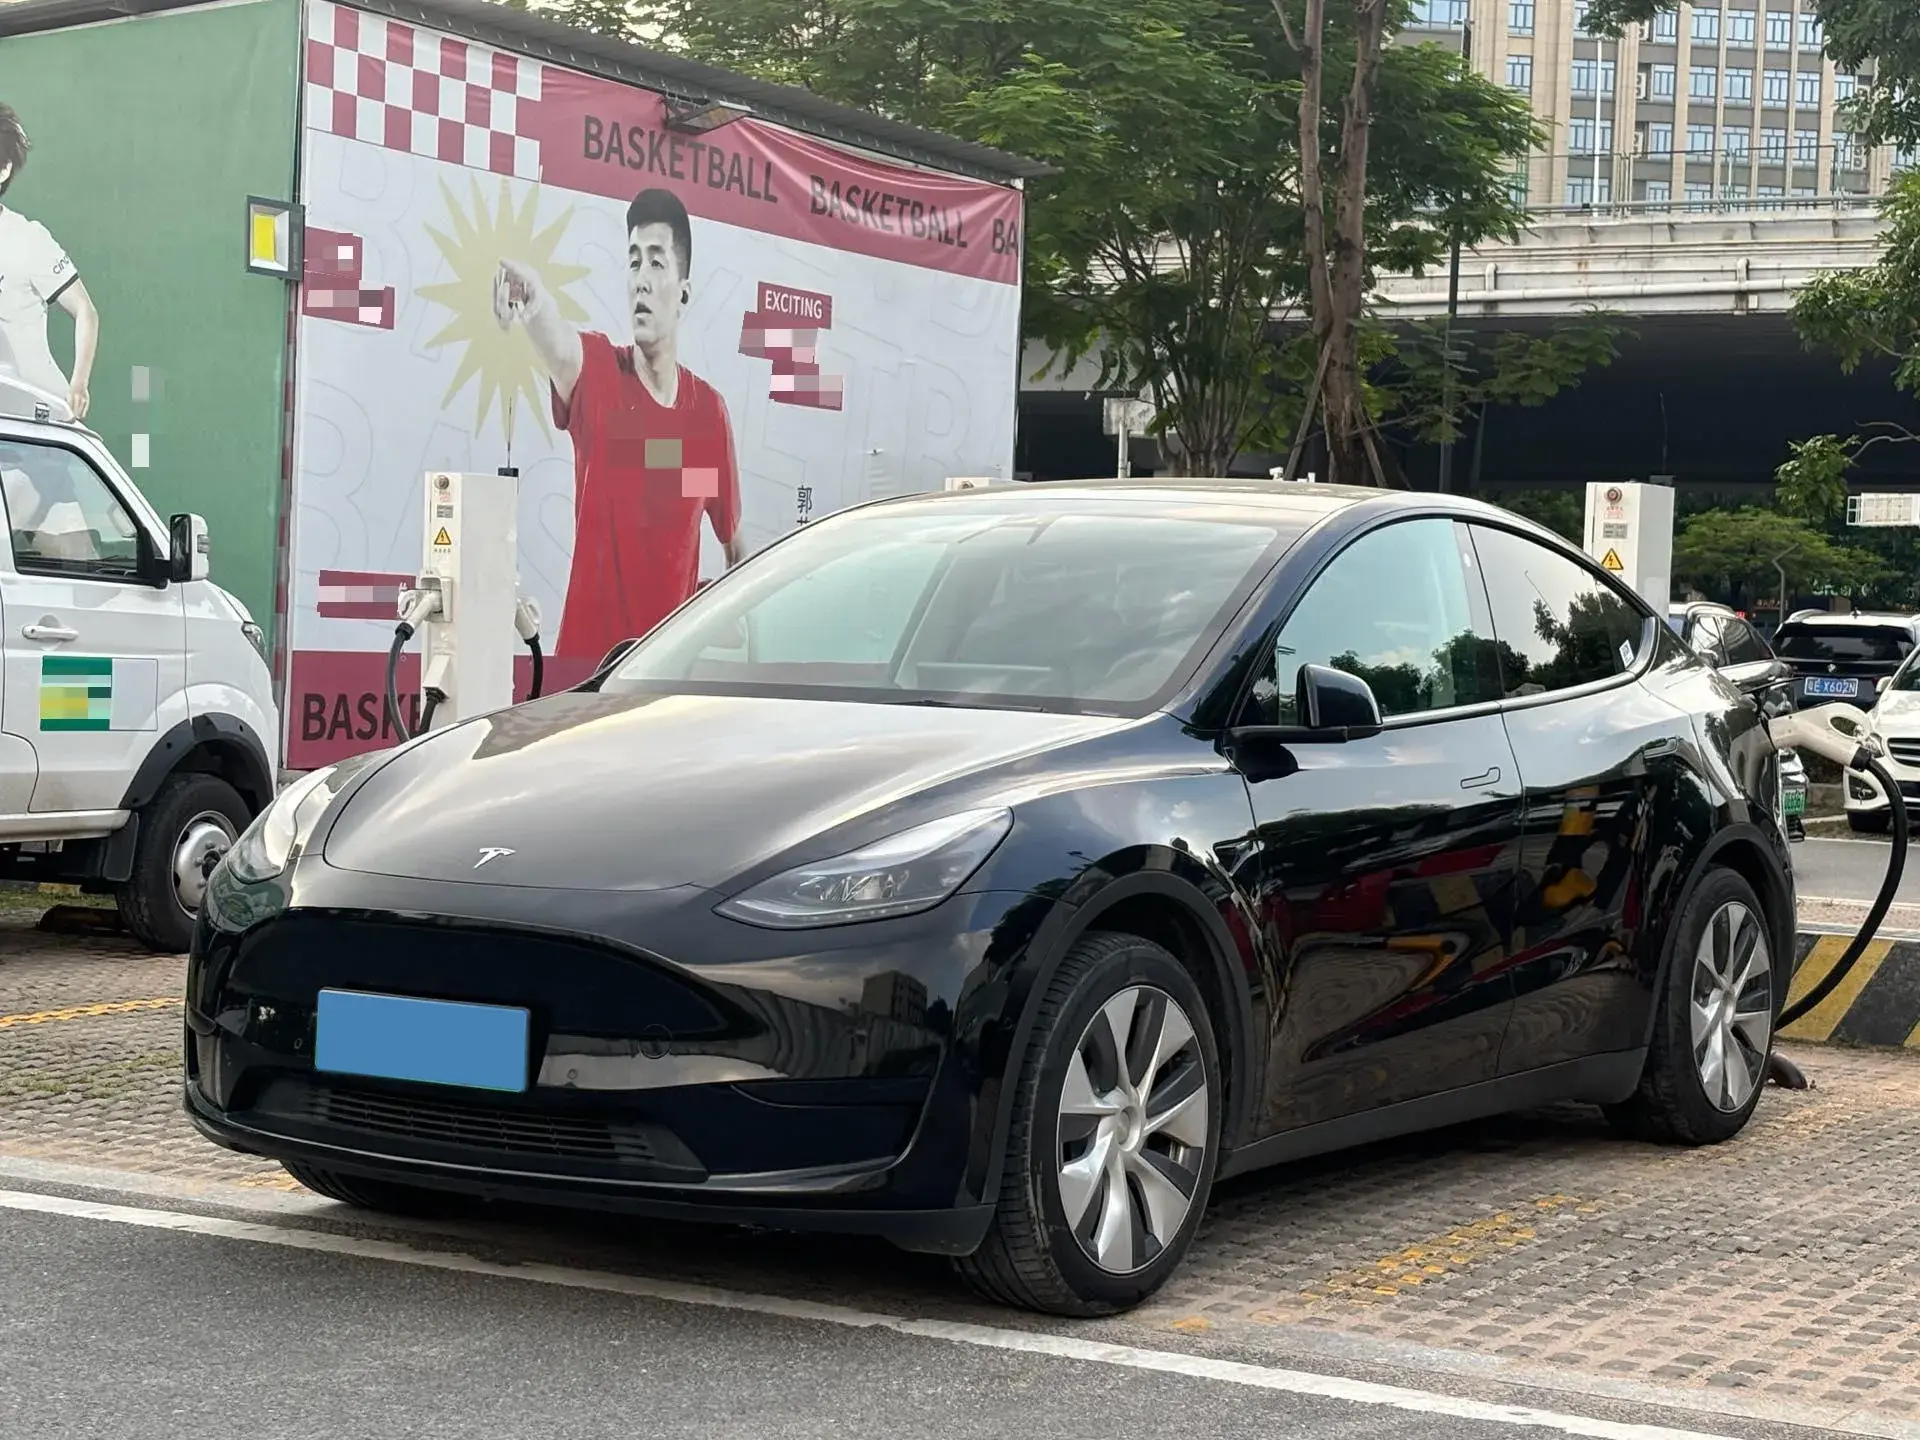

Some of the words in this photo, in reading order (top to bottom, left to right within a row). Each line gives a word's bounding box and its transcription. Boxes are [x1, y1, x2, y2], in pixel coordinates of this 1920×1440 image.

[584, 115, 779, 203] BASKETBALL
[809, 175, 968, 248] BASKETBALL
[765, 289, 823, 320] EXCITING
[797, 485, 813, 526] 郭
